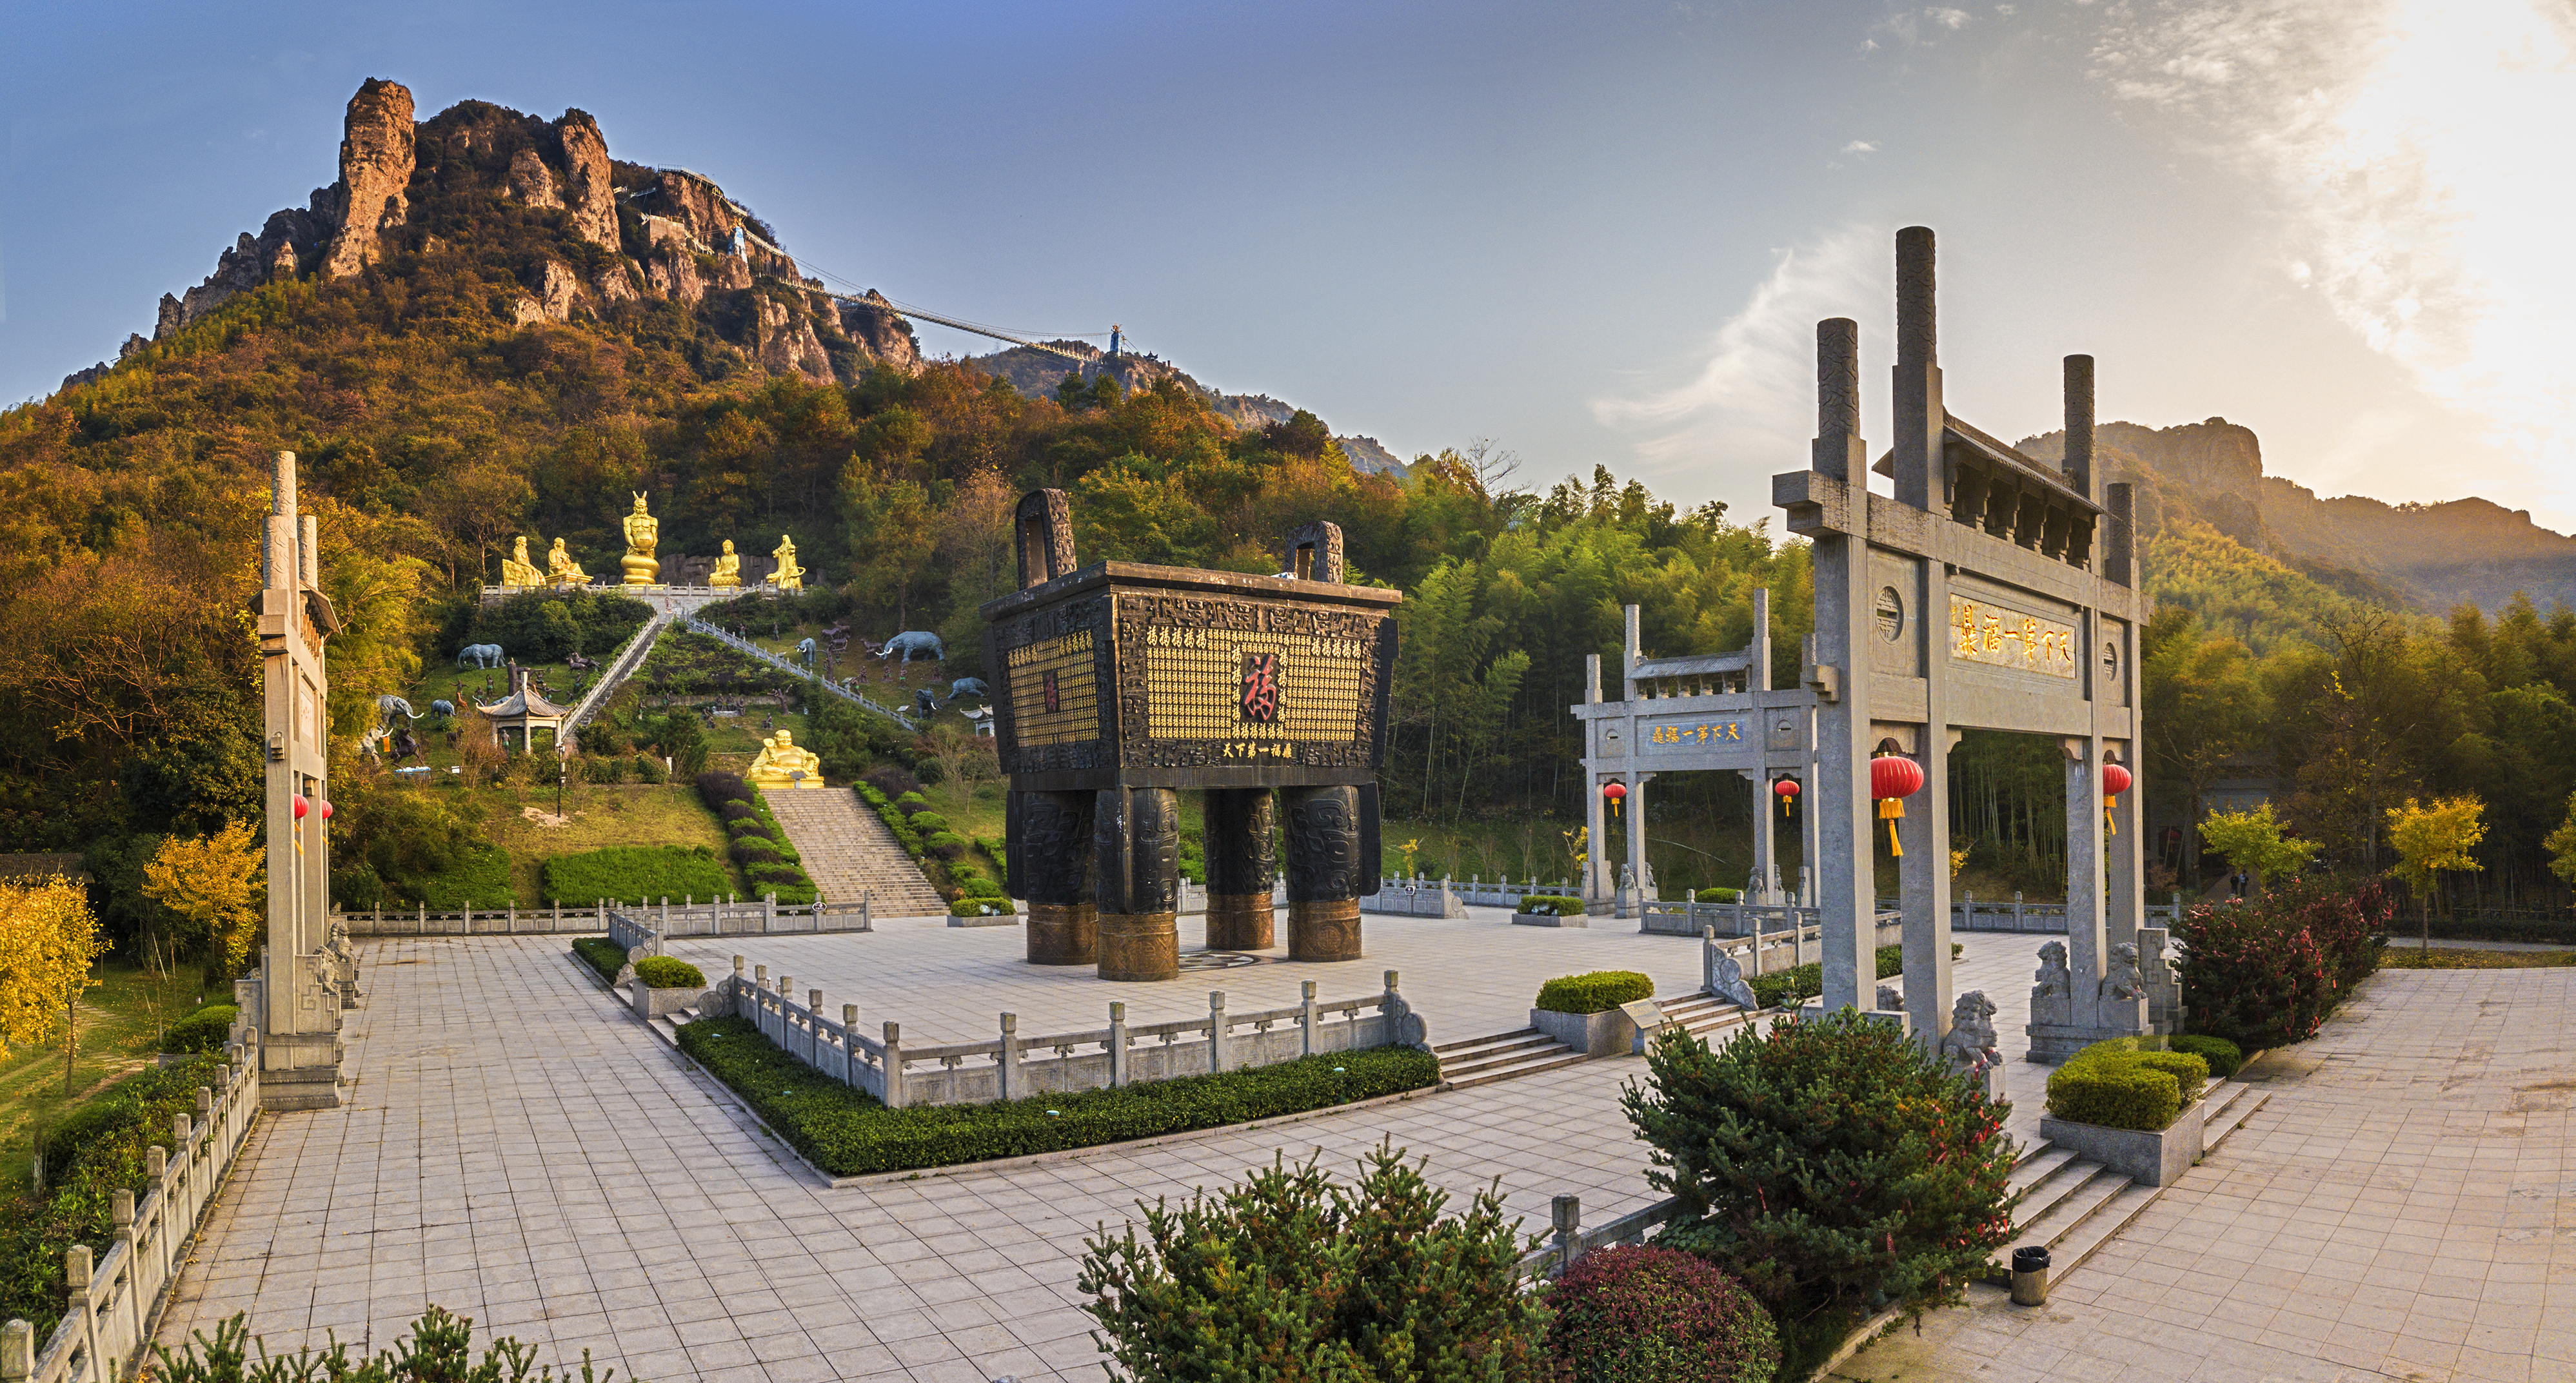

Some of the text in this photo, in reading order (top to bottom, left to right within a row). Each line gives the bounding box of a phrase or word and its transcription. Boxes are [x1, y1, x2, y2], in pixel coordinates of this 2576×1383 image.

[1959, 605, 2071, 663] 天下第一福鼎
[1243, 654, 1276, 720] 福
[1223, 741, 1292, 759] 天下第一福鼎
